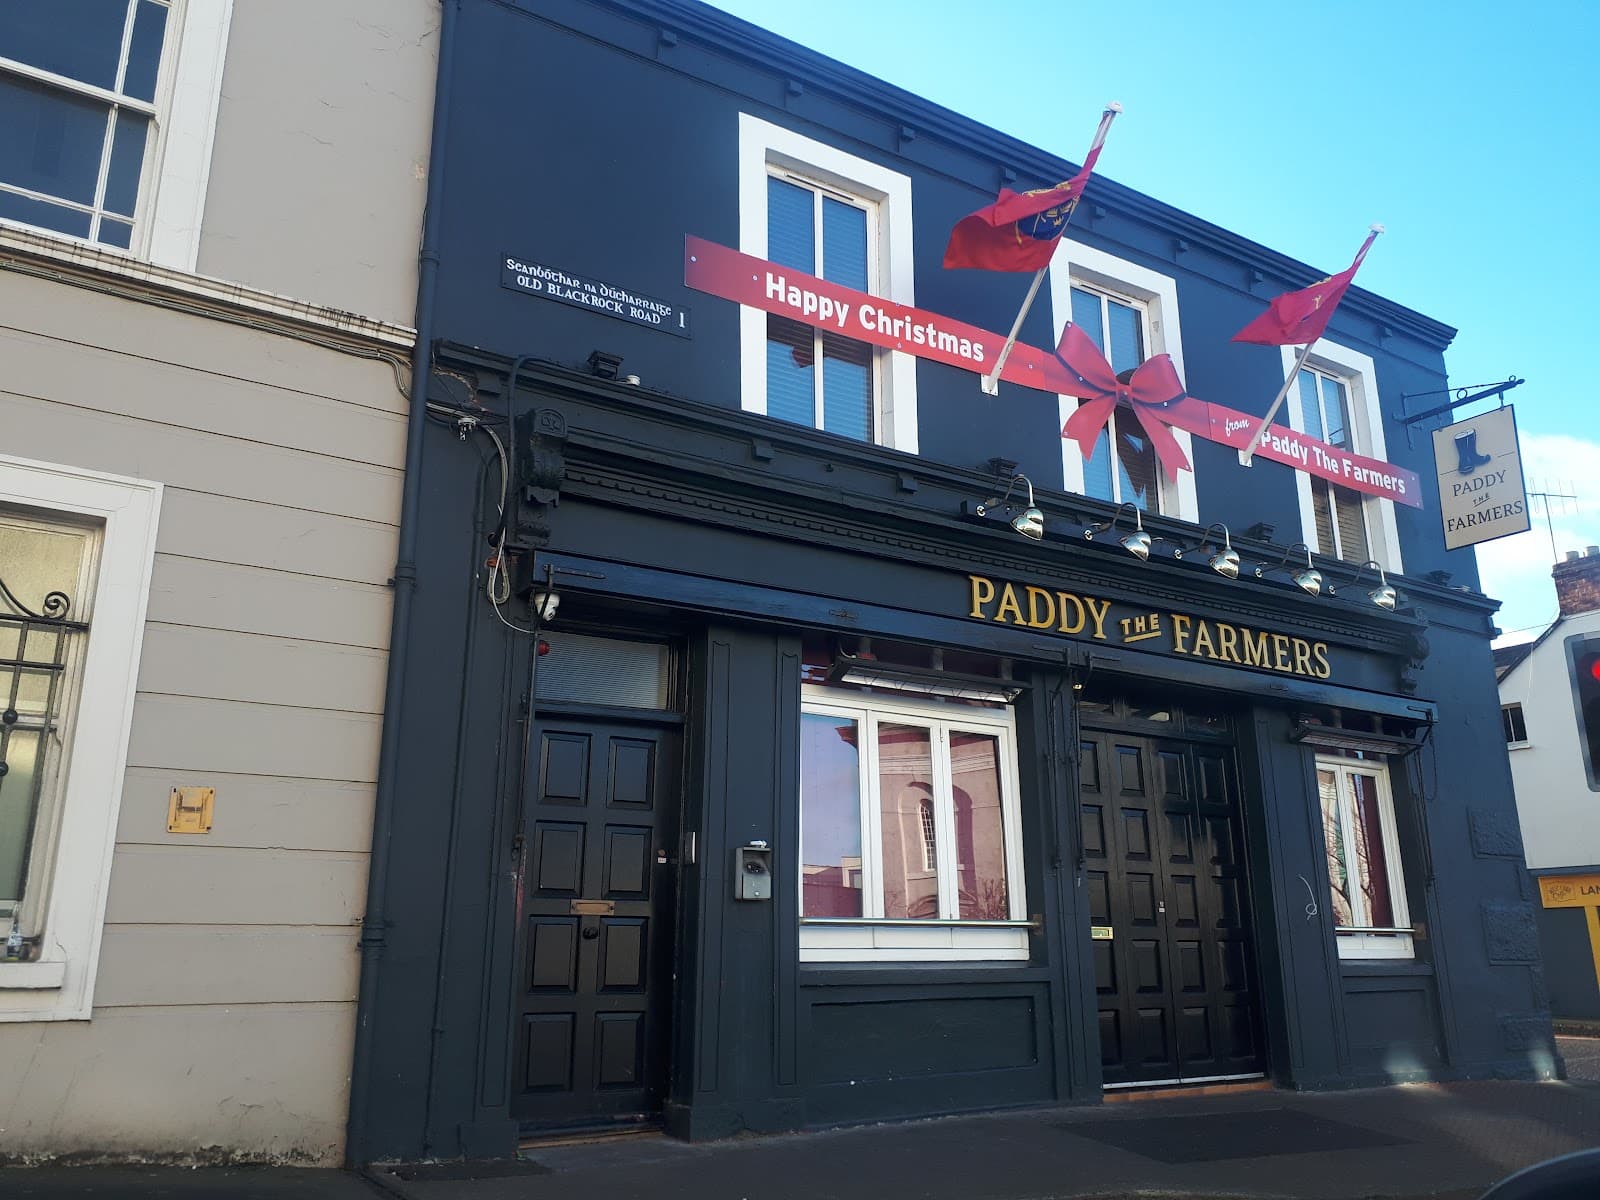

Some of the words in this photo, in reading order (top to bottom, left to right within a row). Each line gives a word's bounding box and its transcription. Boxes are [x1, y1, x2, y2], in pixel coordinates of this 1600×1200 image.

[517, 275, 542, 290] OLD
[547, 282, 624, 314] BLACKROCK
[630, 306, 661, 325] ROAD
[583, 283, 597, 294] na
[765, 272, 850, 327] Happy
[859, 304, 985, 363] Christmas
[1225, 417, 1250, 437] from
[1260, 431, 1309, 465] Paddy
[1313, 446, 1339, 474] The
[1342, 458, 1406, 494] Farmers
[1452, 470, 1507, 497] PADDY
[1473, 493, 1491, 505] THE
[1447, 500, 1523, 532] FARMERS
[968, 575, 1112, 640] PADDY
[1120, 612, 1160, 635] THE
[1170, 613, 1332, 680] FARMERS
